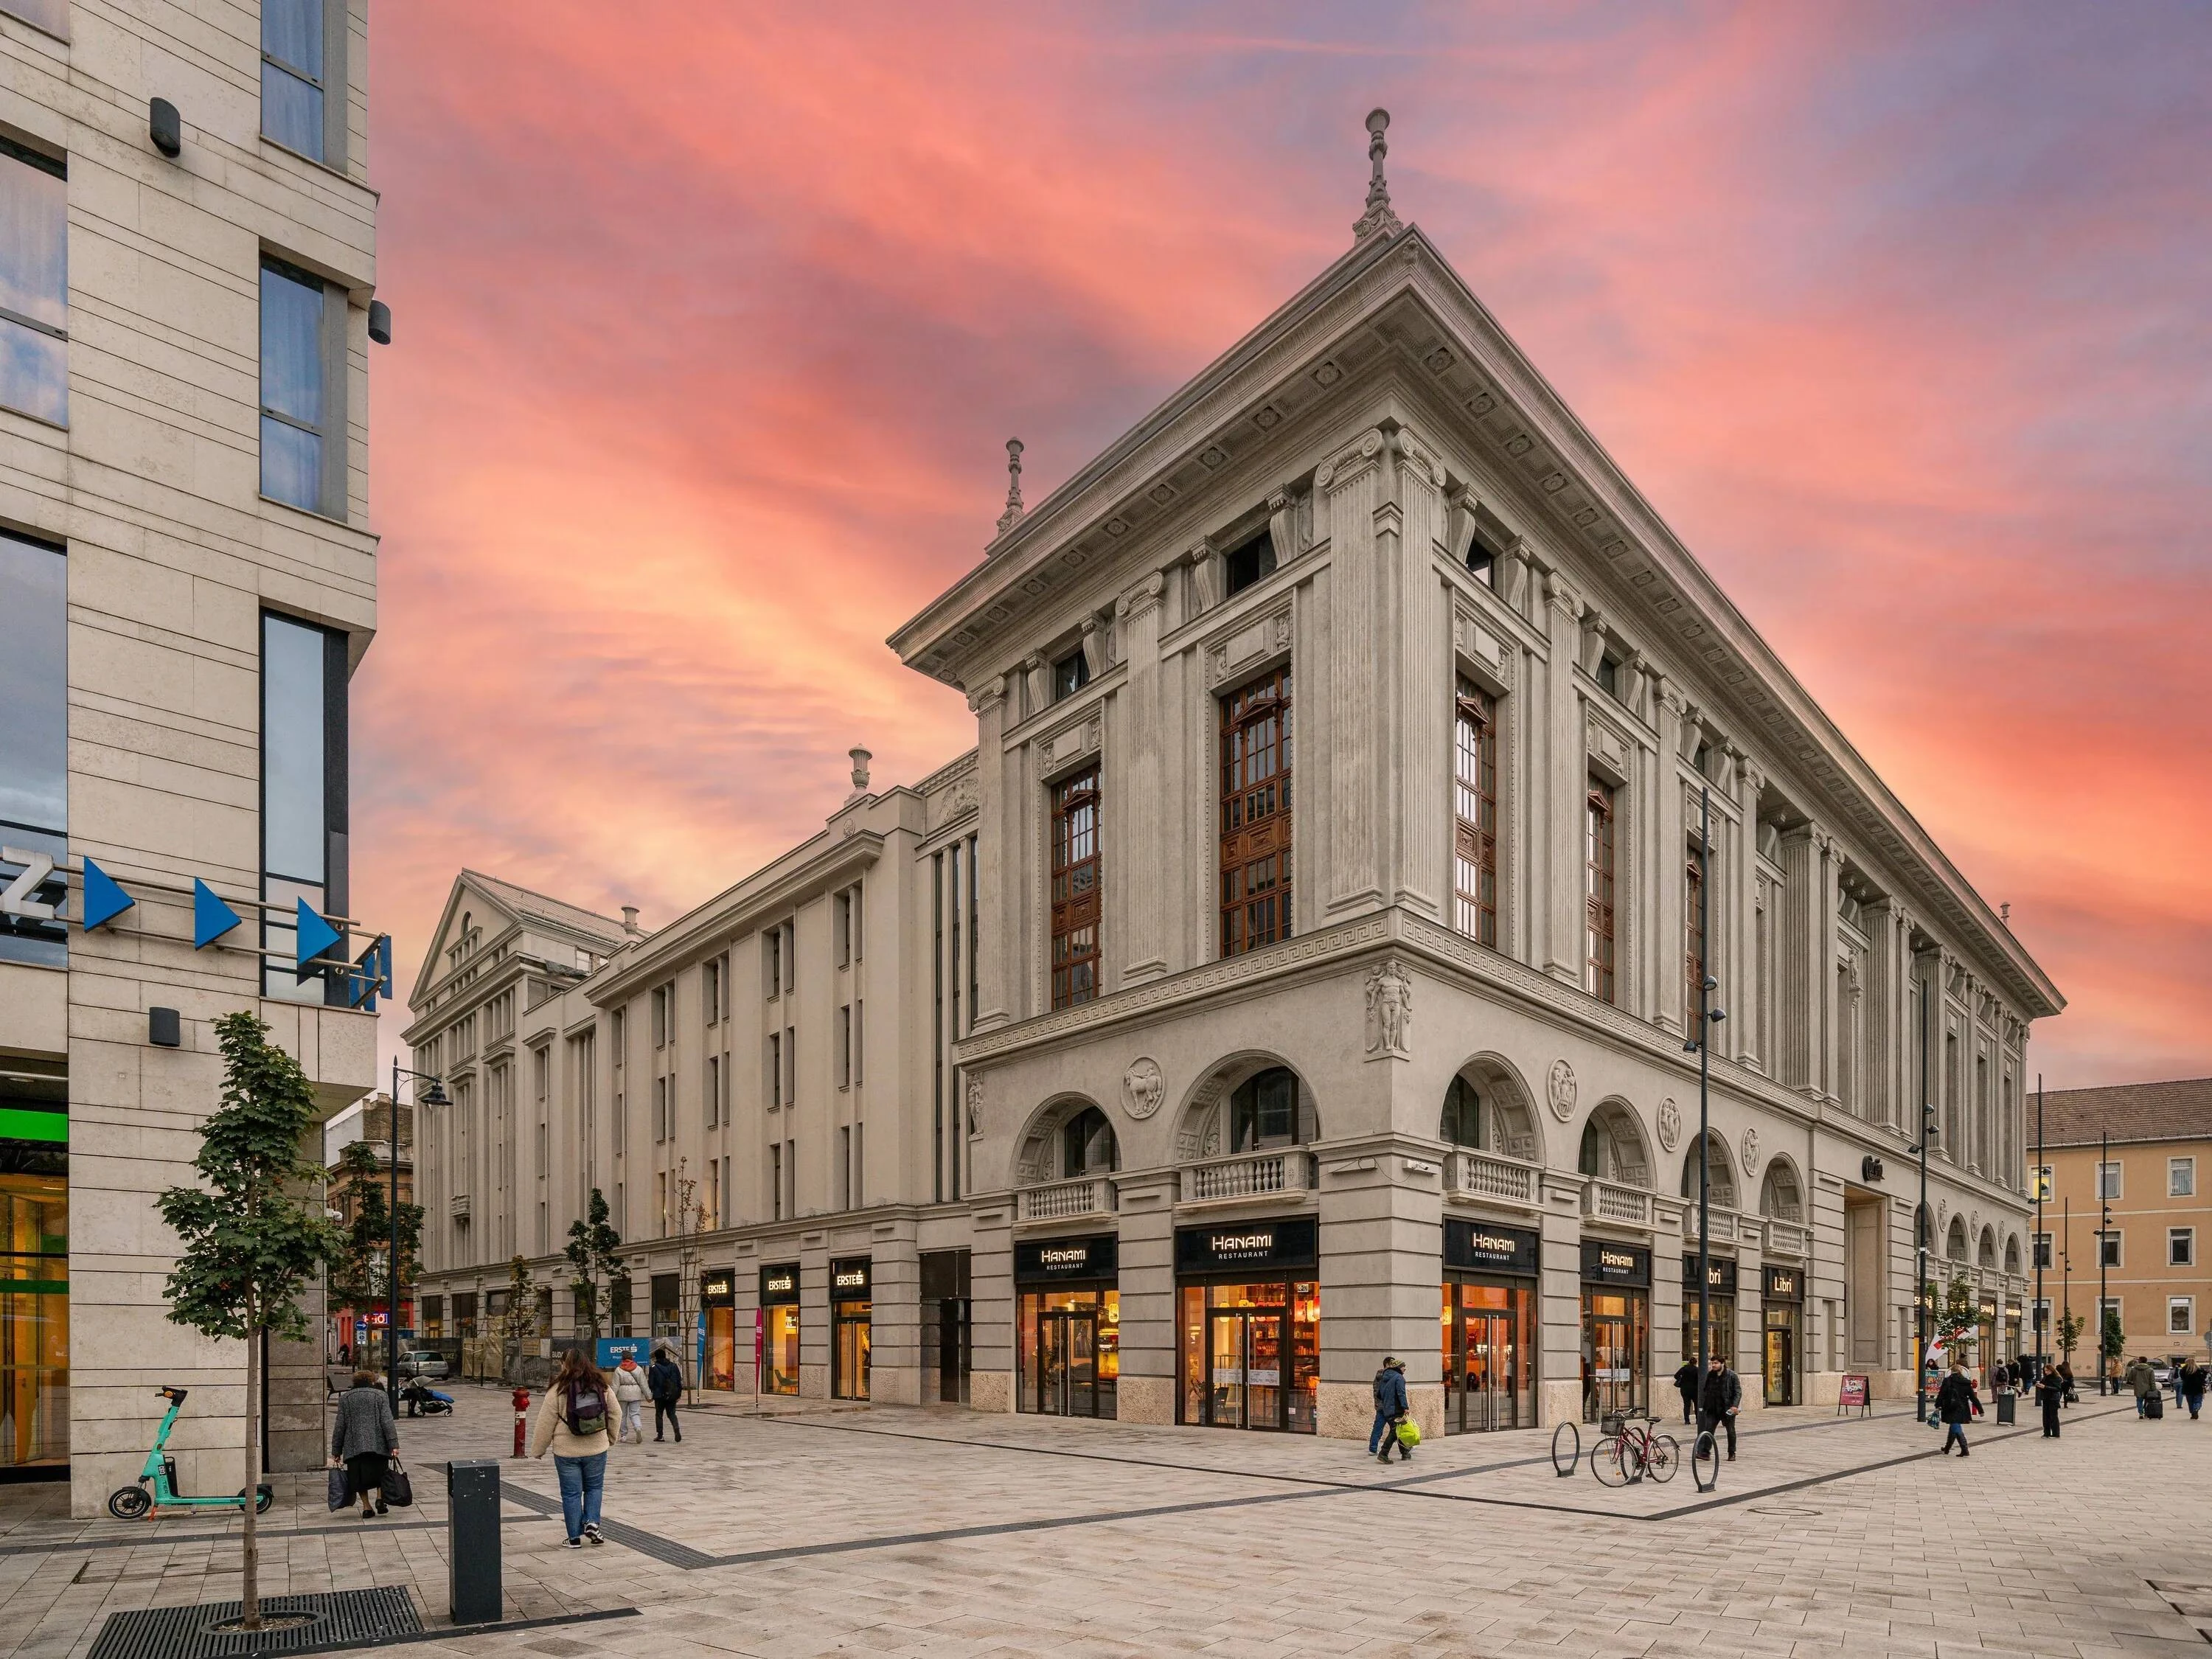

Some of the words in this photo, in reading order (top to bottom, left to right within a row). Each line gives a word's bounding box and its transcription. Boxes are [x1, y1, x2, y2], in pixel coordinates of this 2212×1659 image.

[1218, 1251, 1268, 1259] RESTAURANT
[1475, 1251, 1510, 1261] RESTAURANT
[1046, 1262, 1083, 1270] RESTAURANT
[1602, 1267, 1629, 1275] RESTAURANT
[768, 1279, 786, 1290] ERSTE
[837, 1274, 857, 1286] ERSTE
[1774, 1276, 1792, 1293] Libri
[708, 1284, 723, 1294] ERSTE
[1980, 1304, 1992, 1313] SPAR
